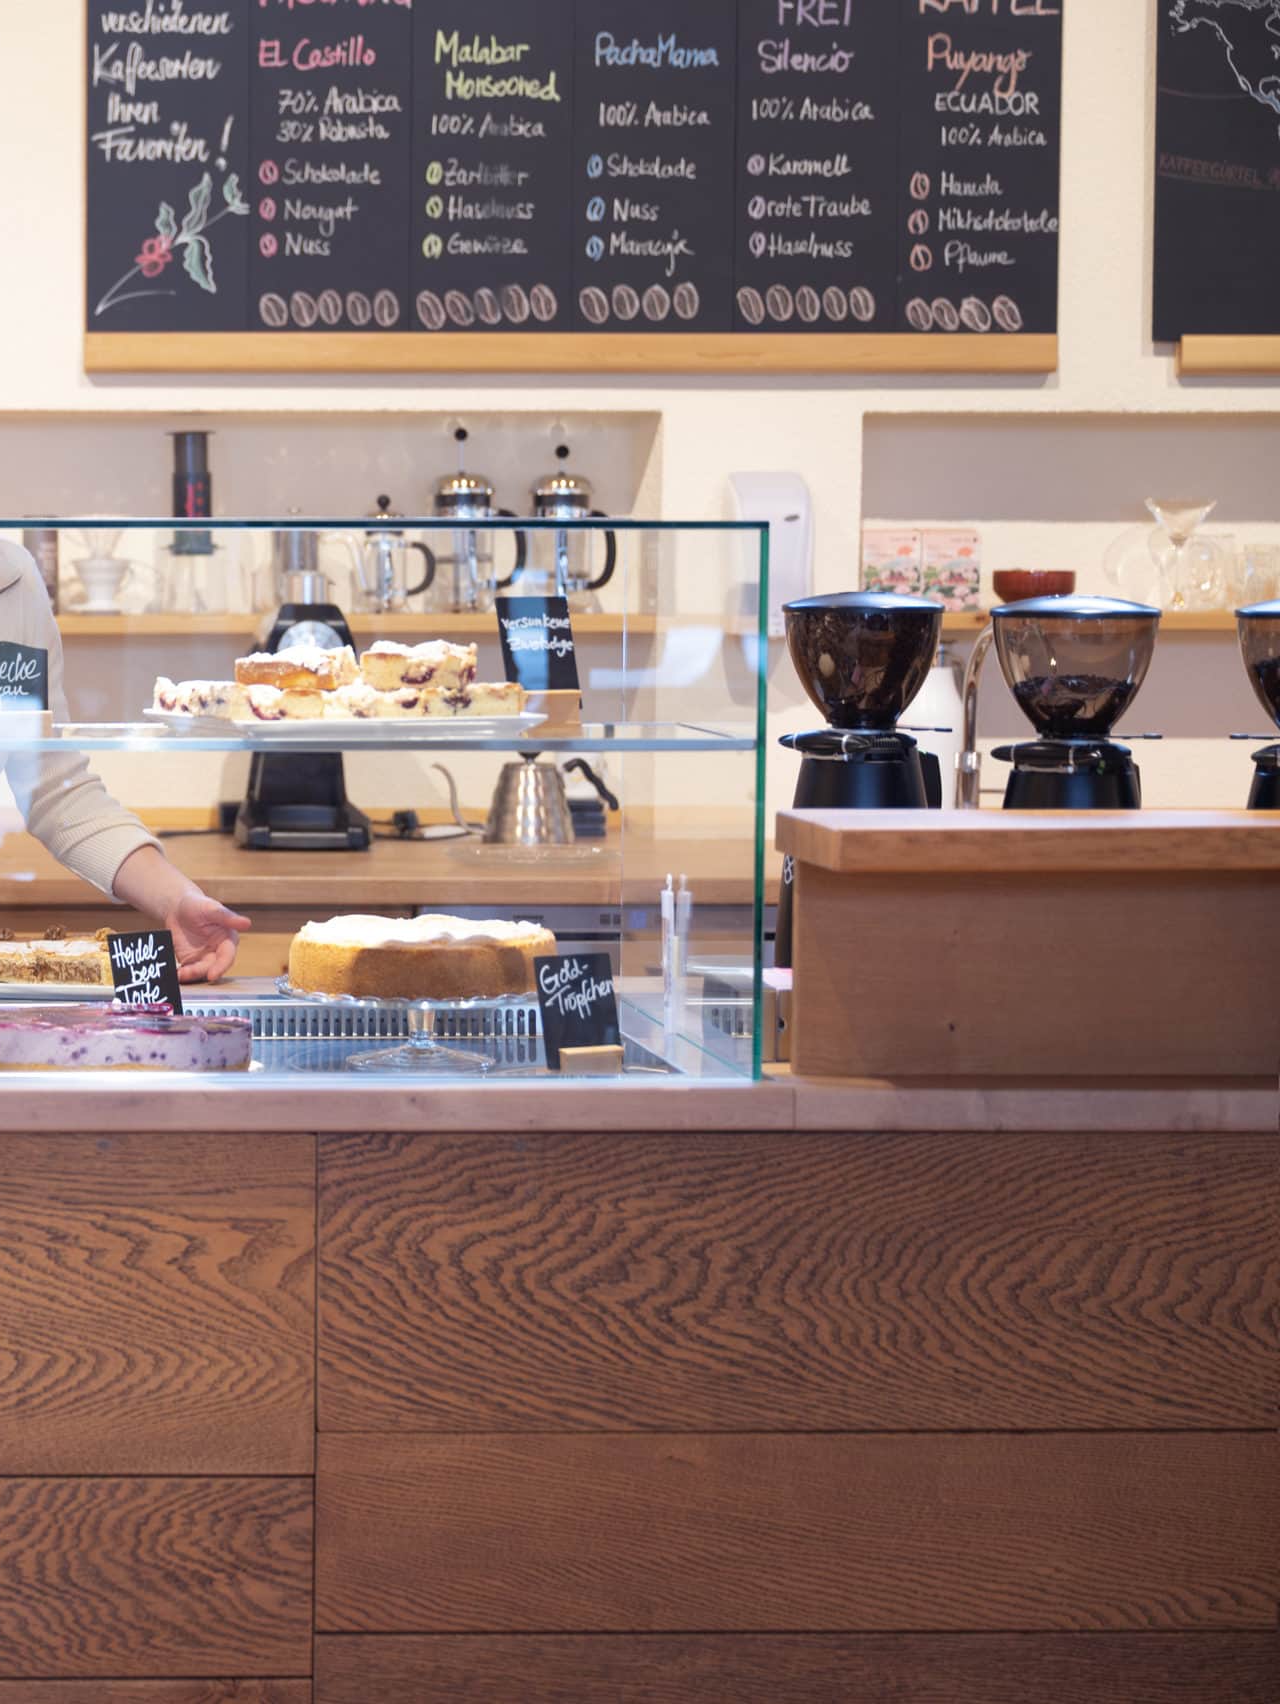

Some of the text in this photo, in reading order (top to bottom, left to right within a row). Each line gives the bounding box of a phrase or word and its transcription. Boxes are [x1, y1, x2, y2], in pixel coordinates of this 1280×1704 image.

[101, 0, 232, 34] verschiedenen
[292, 35, 376, 70] Castillo
[434, 29, 530, 67] Malabar
[93, 41, 221, 96] Kaffeesorten
[927, 32, 1033, 98] Puyango
[278, 85, 402, 114] 70% Arabica
[445, 70, 561, 102] Monsooned
[599, 100, 711, 127] 100% Arabica
[751, 97, 874, 121] 100% Arabica
[935, 91, 1040, 116] ECUADOR
[276, 115, 391, 142] 30% Robusta
[431, 113, 474, 136] 100%
[941, 122, 1048, 147] 100% Arabica
[281, 158, 381, 185] Schokolade
[607, 152, 696, 179] Schokolade
[768, 152, 852, 178] Karamell
[284, 197, 358, 236] Nougat
[613, 197, 659, 222] Nuss
[767, 193, 872, 218] rote Traube
[284, 232, 330, 257] Nuss
[768, 231, 854, 259] Haselnuss
[944, 240, 1016, 273] Pflaume
[111, 933, 165, 969] Heidel-
[539, 958, 589, 995] Gold-
[115, 980, 168, 1006] Torte
